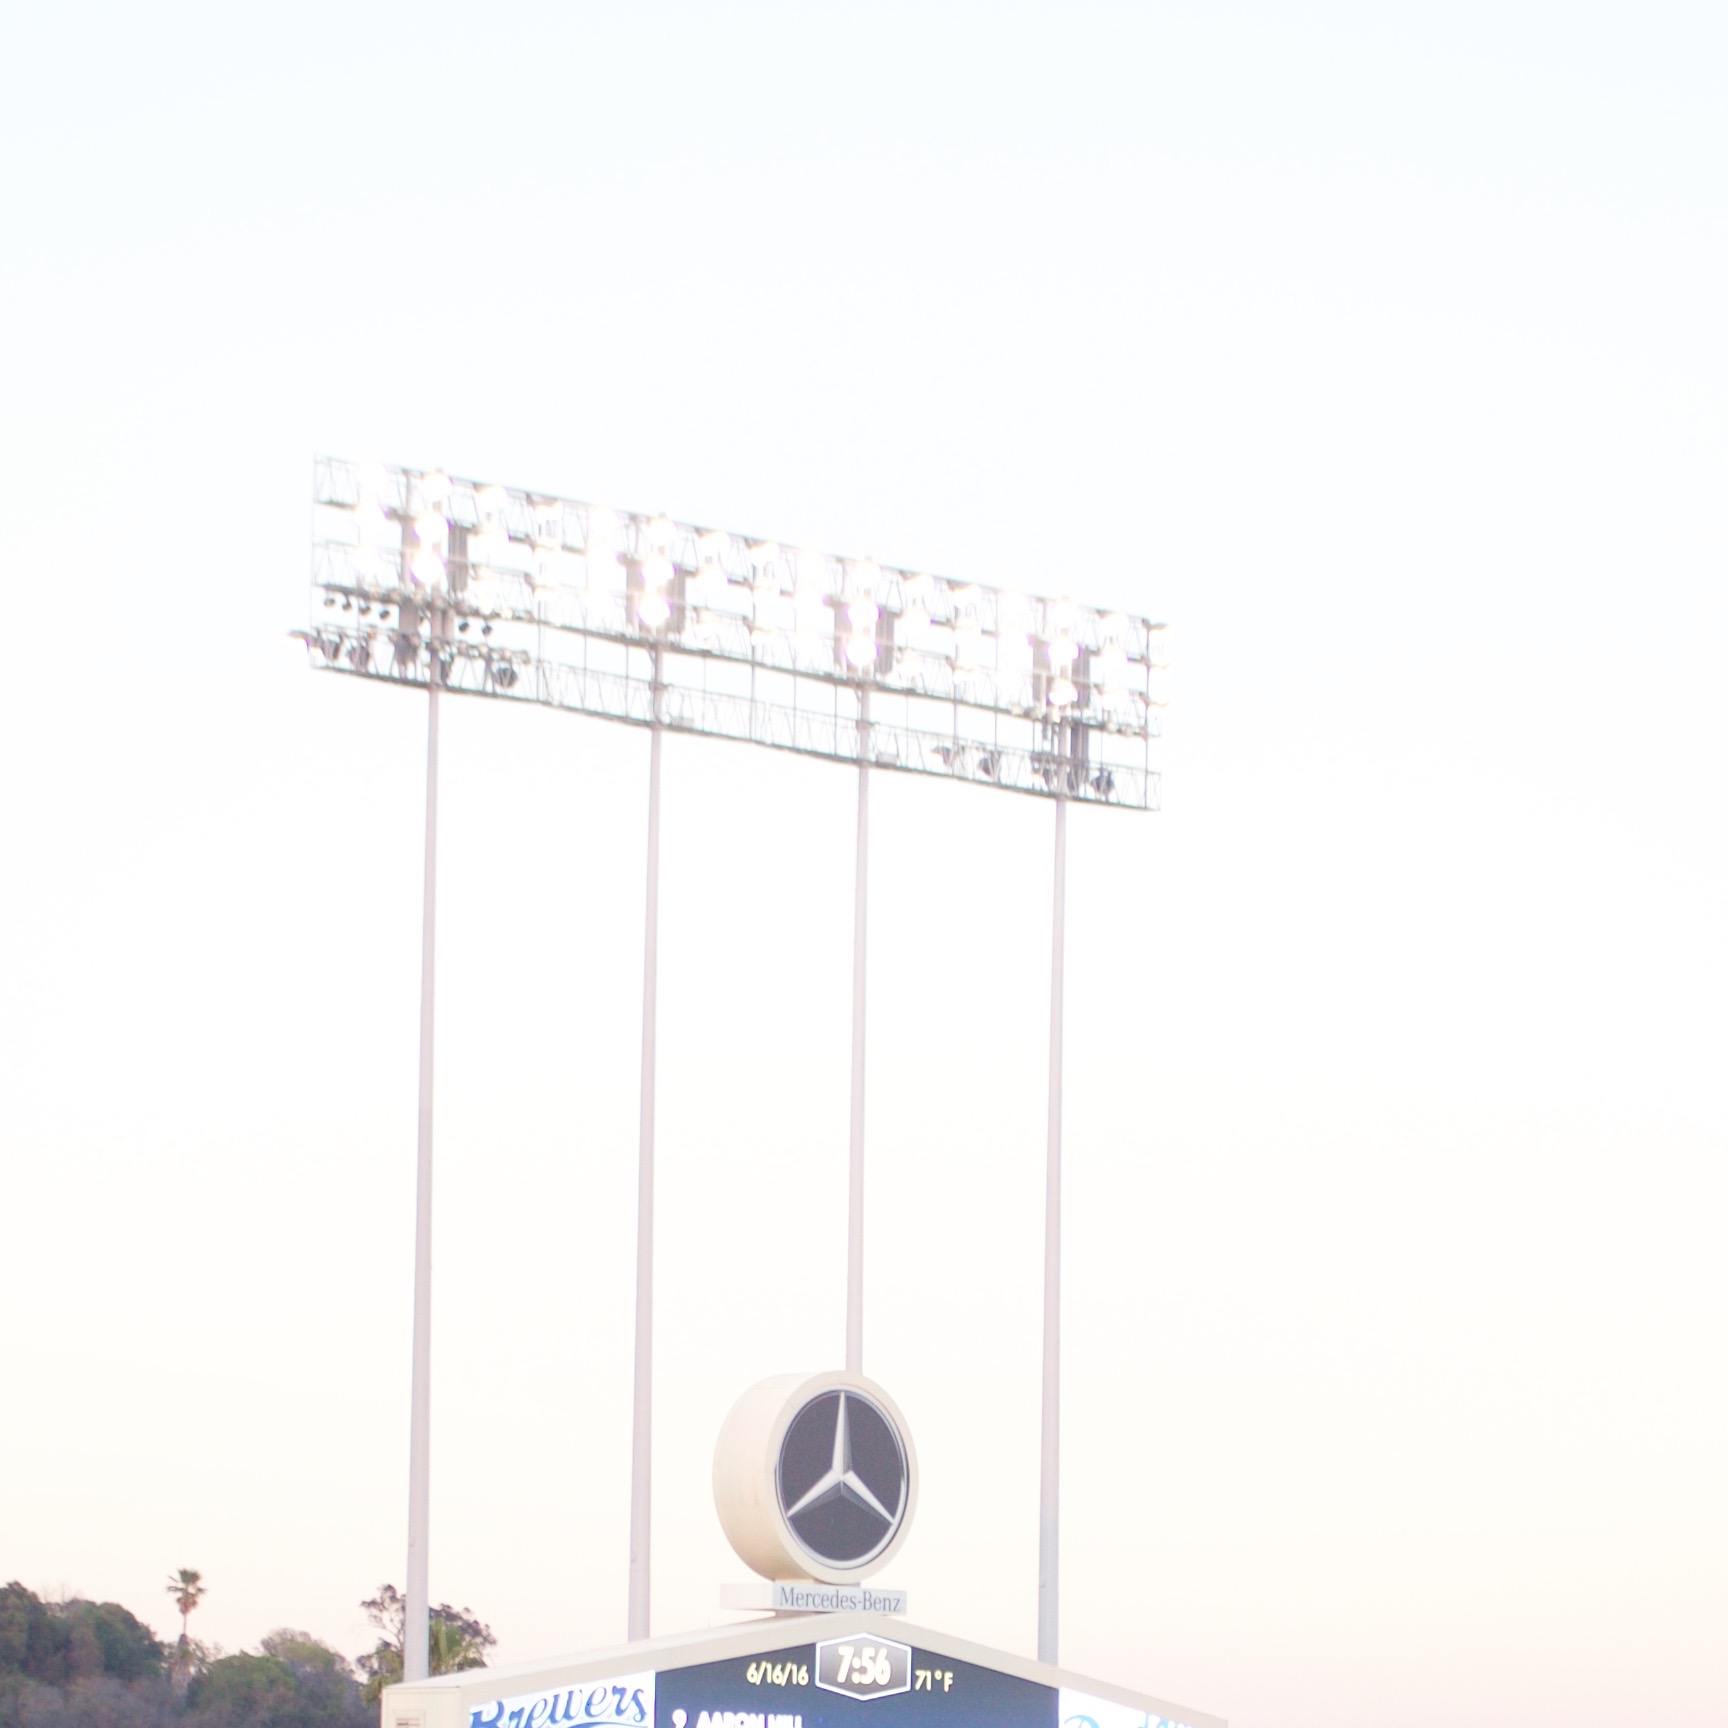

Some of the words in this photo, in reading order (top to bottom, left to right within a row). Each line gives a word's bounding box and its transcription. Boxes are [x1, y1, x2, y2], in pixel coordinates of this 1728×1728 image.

[780, 1586, 901, 1613] Mercedes-Benz
[747, 1661, 809, 1686] 6/16/16
[837, 1646, 892, 1686] 7:56
